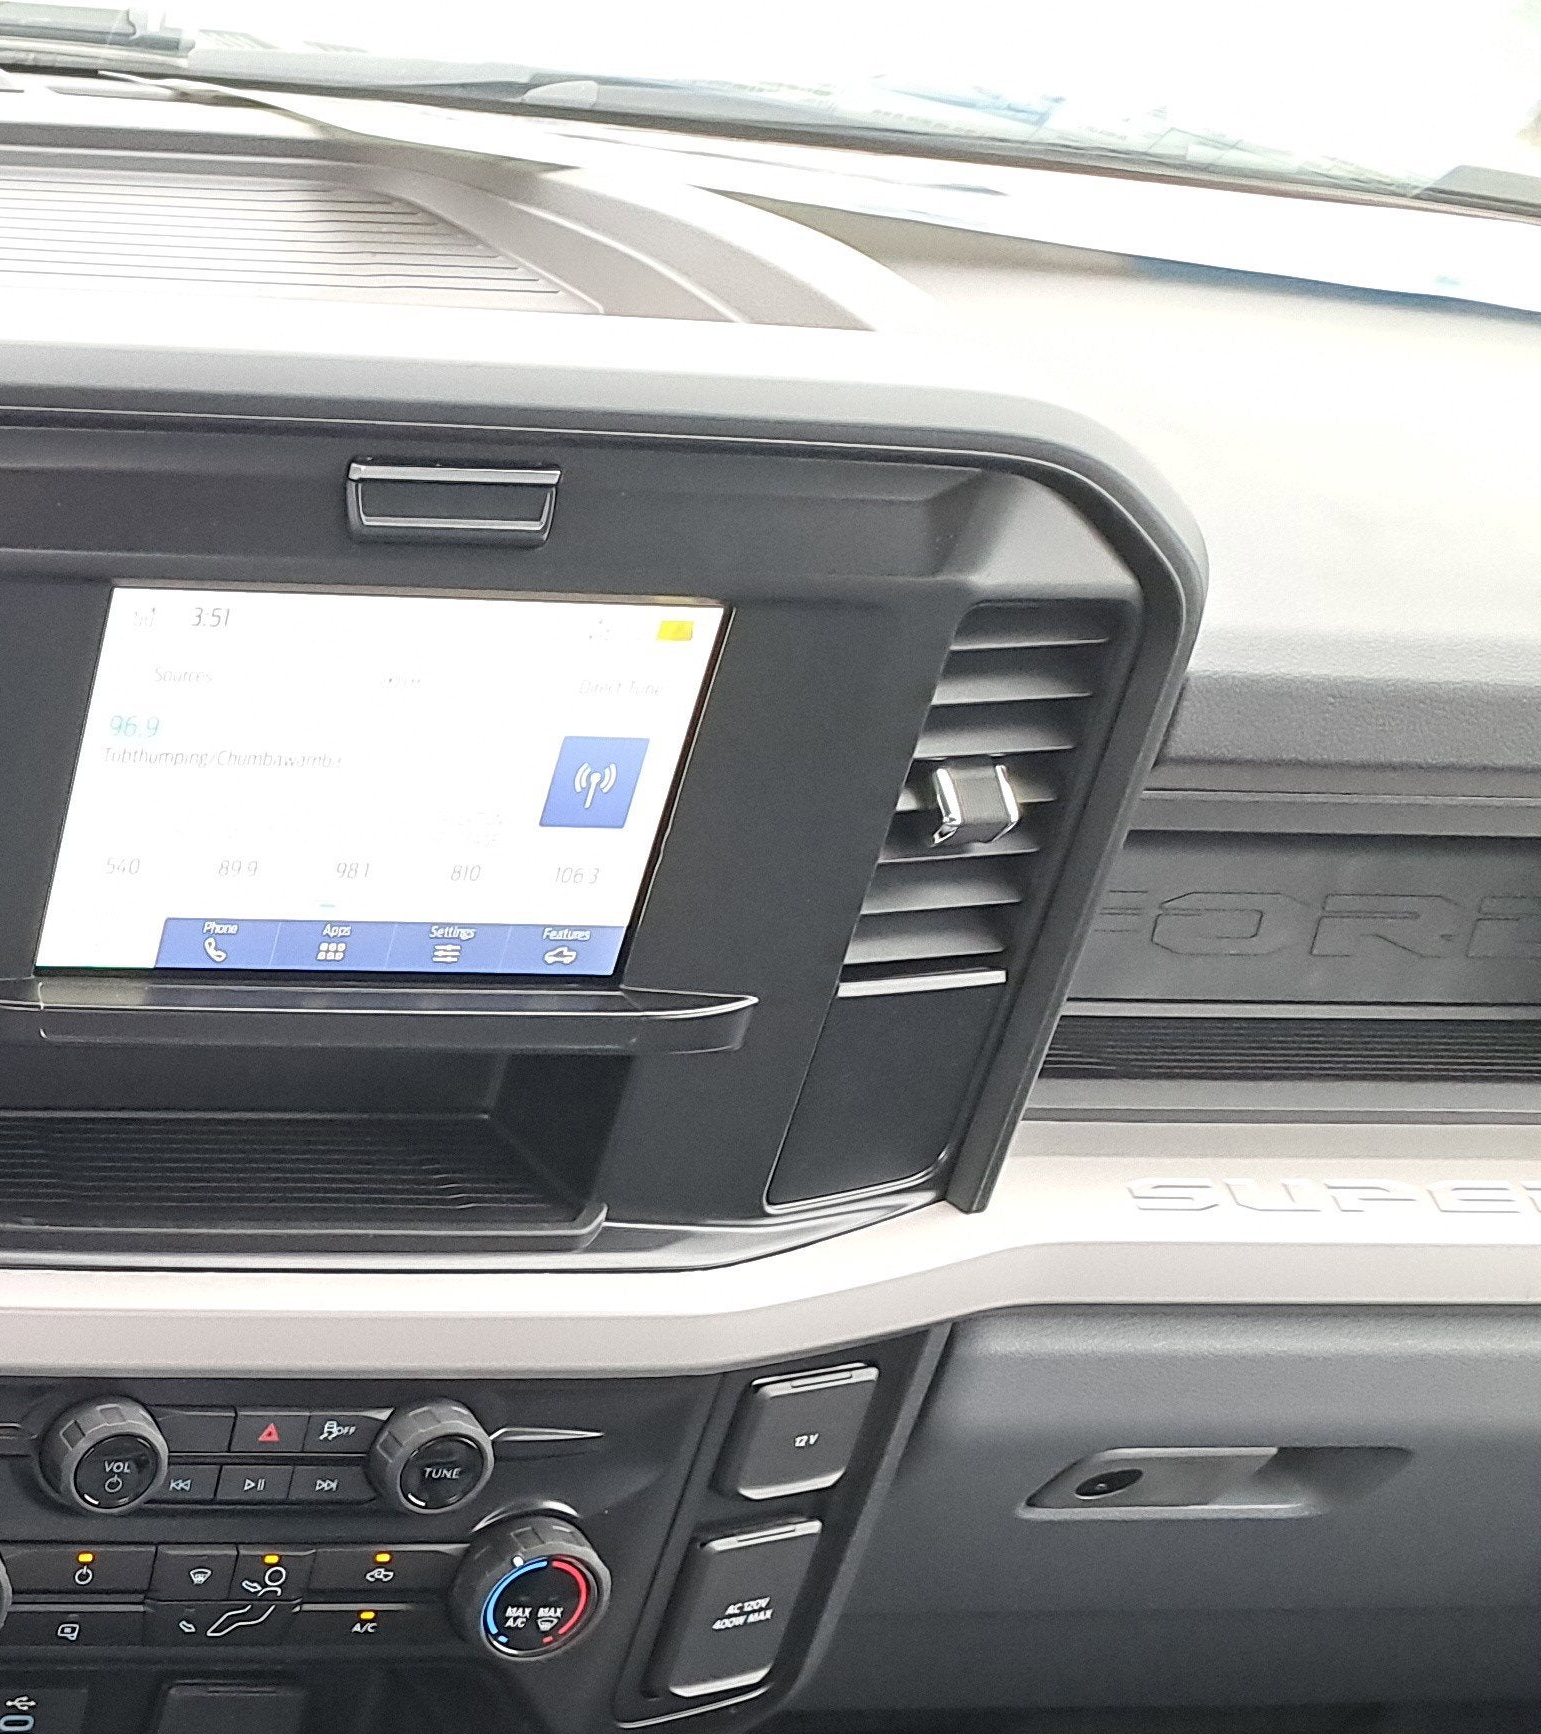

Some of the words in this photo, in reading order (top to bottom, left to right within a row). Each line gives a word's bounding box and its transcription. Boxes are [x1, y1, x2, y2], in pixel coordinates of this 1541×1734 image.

[191, 607, 230, 629] 3:51
[109, 714, 160, 738] 96.9
[203, 920, 239, 936] Phone
[322, 922, 352, 939] Apps
[429, 924, 476, 941] Settings
[542, 926, 591, 942] Features
[1126, 1176, 1541, 1216] SUPE
[104, 1460, 131, 1474] VOL
[424, 1467, 461, 1480] TUNE
[505, 1606, 532, 1618] MAX
[537, 1607, 564, 1618] MAX
[351, 1622, 378, 1633] A/C
[504, 1617, 527, 1628] A/C
